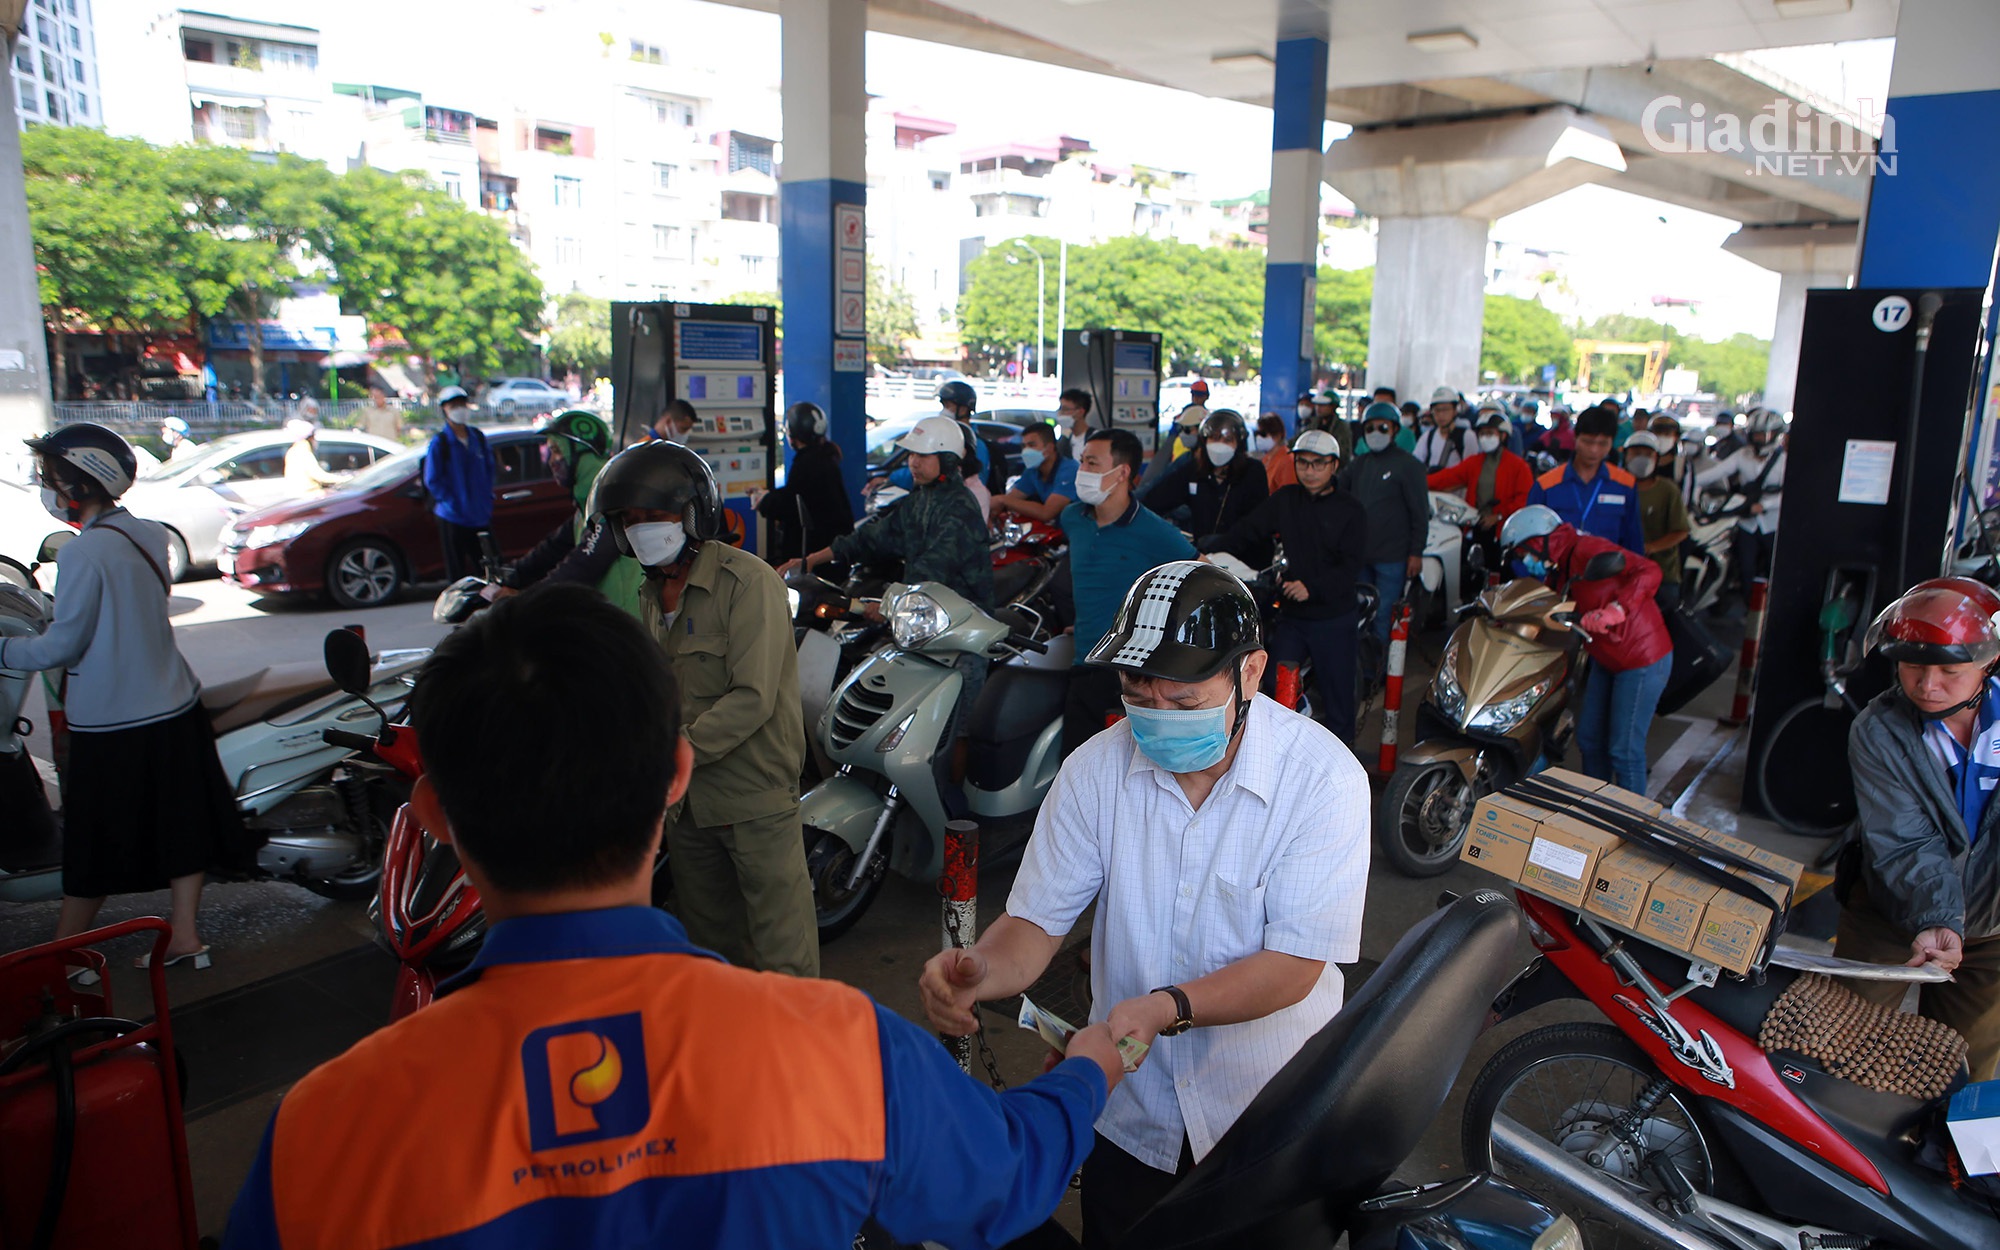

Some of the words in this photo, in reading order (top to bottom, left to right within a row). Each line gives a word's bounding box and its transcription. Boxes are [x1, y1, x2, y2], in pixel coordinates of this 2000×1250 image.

[1880, 306, 1906, 322] 17
[1475, 827, 1499, 842] TONER
[512, 1137, 677, 1186] PETROLIMEX
